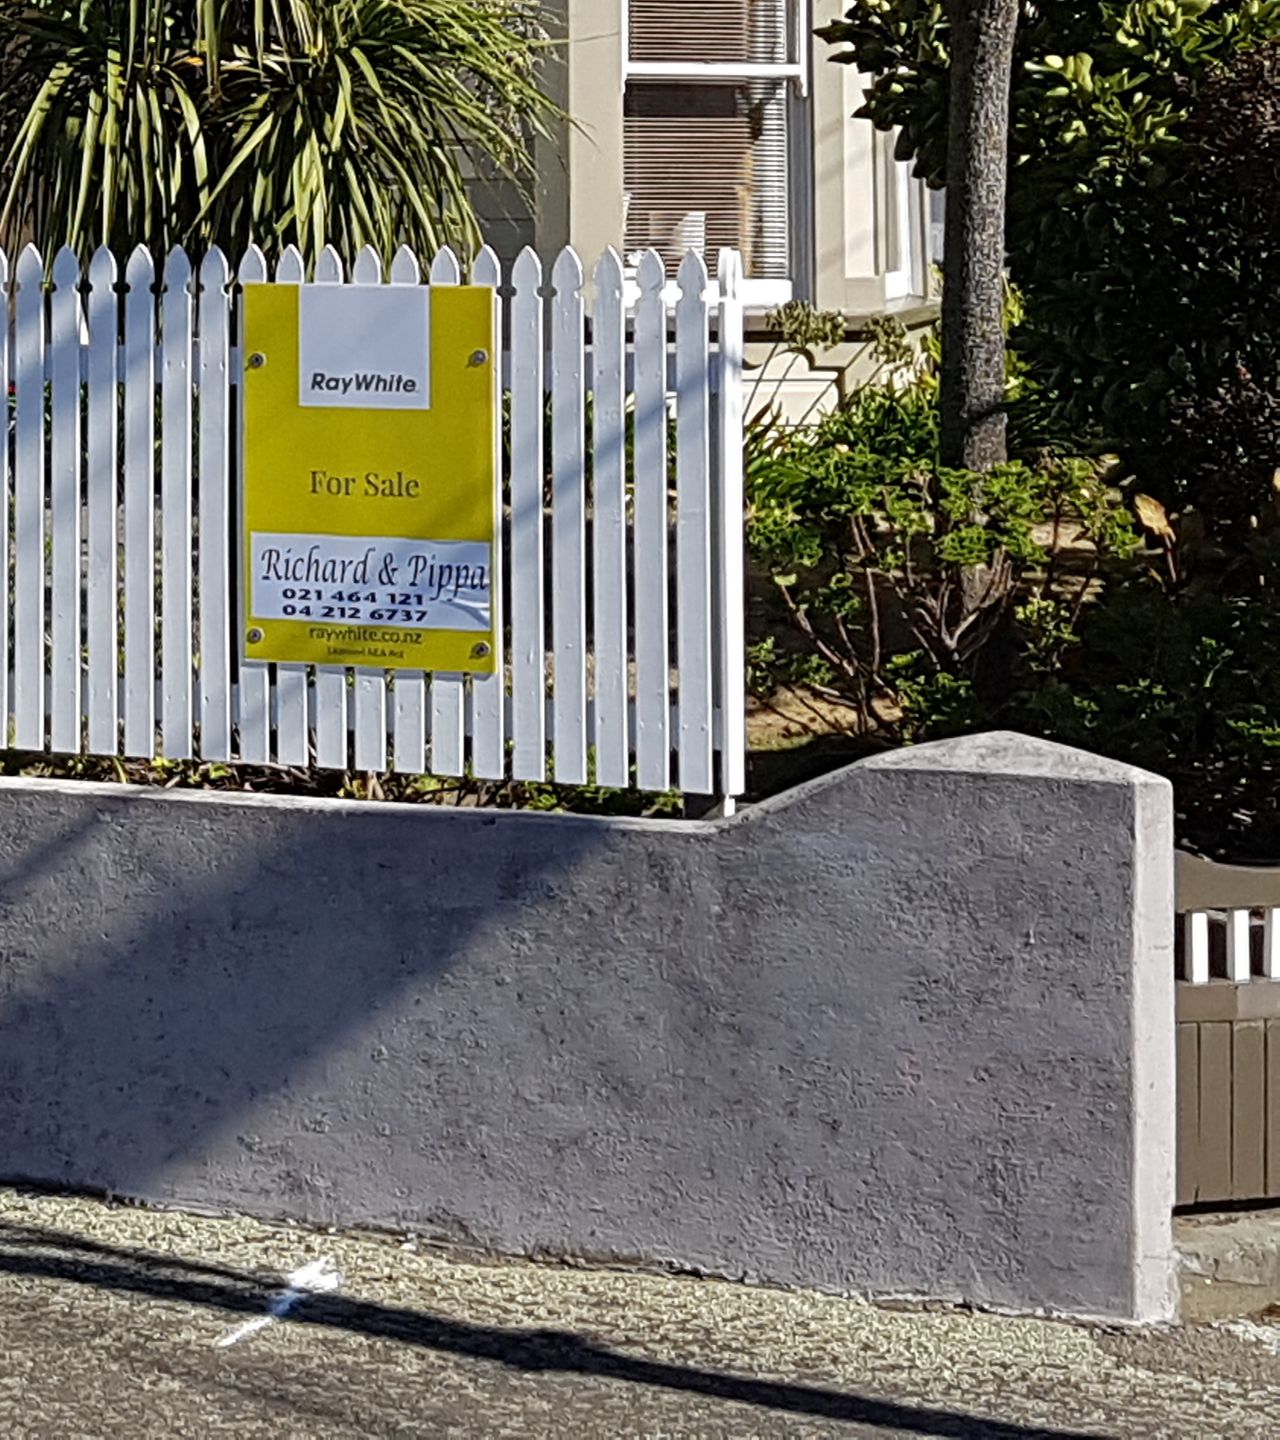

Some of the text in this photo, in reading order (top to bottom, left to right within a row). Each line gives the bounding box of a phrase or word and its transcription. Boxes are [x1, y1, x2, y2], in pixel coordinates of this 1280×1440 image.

[310, 471, 420, 498] For Sale
[261, 545, 489, 601] Richard & Pippa
[282, 588, 424, 606] 021 464 121
[282, 604, 428, 622] 04 212 6737
[309, 627, 422, 645] raywhite.co.nz
